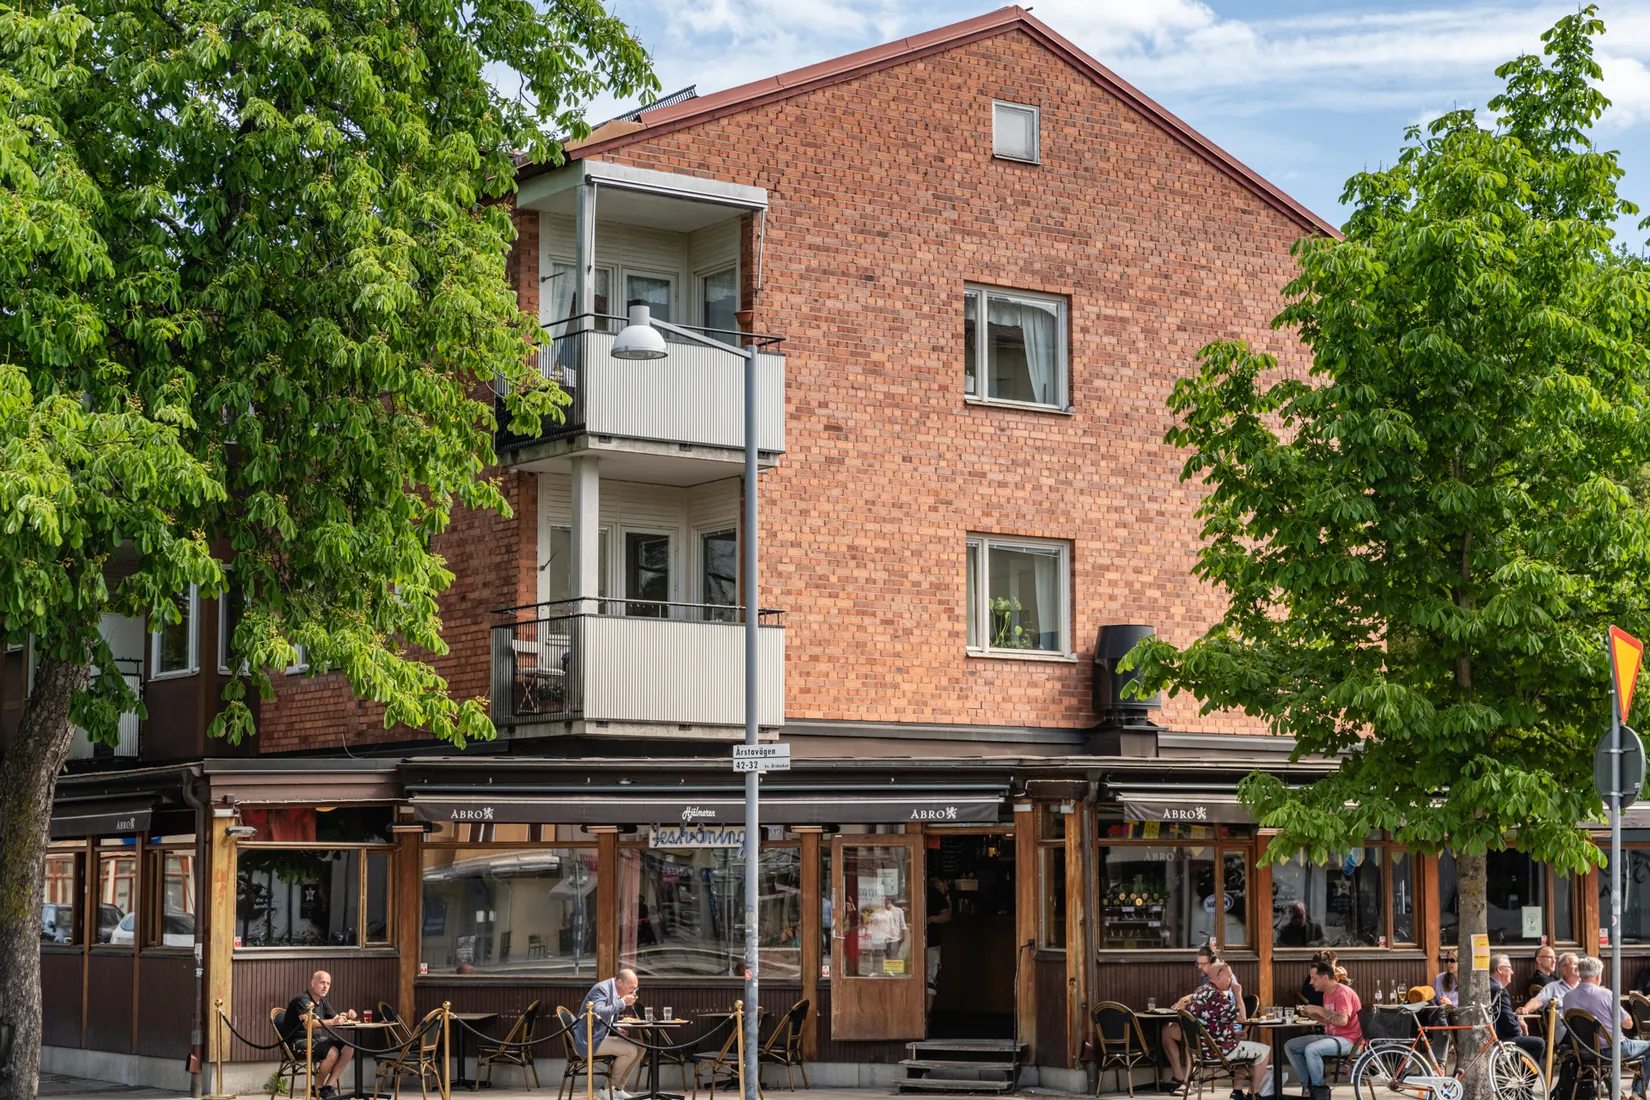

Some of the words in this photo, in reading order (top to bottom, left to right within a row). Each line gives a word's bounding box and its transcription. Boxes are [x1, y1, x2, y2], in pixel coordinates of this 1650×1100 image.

[735, 745, 776, 757] Årstavägen
[735, 760, 758, 770] 42-32
[450, 809, 483, 819] ÅBRO
[910, 809, 945, 819] ÅBRO
[1162, 808, 1196, 819] ÅBRO
